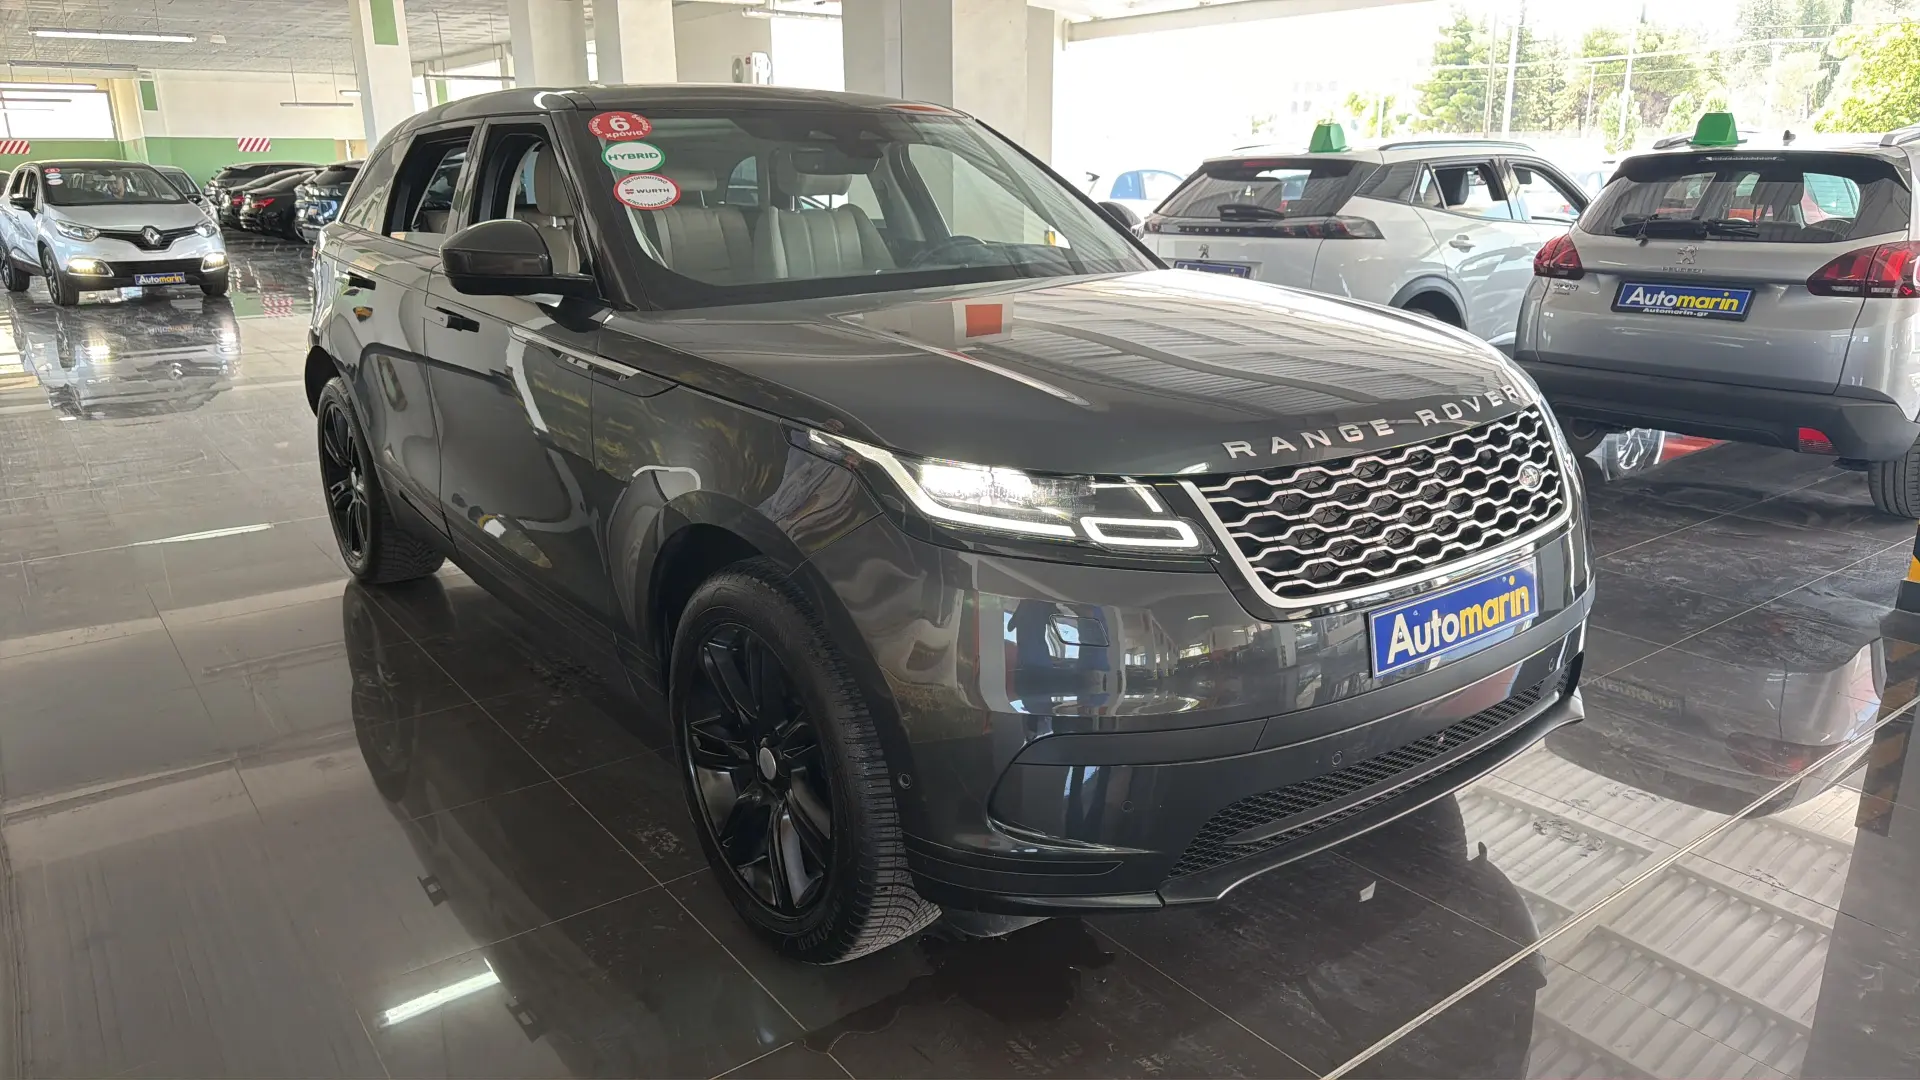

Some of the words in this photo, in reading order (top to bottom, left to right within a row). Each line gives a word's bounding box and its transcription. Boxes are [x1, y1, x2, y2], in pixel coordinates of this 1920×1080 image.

[609, 117, 630, 131] 6
[608, 152, 659, 160] HYBRID
[139, 273, 183, 284] Automarin
[1626, 286, 1739, 311] Automarin
[1642, 307, 1709, 318] Automarin.gr
[1222, 418, 1395, 459] RANGE
[1415, 384, 1519, 427] ROVER
[1387, 575, 1529, 664] Automarin
